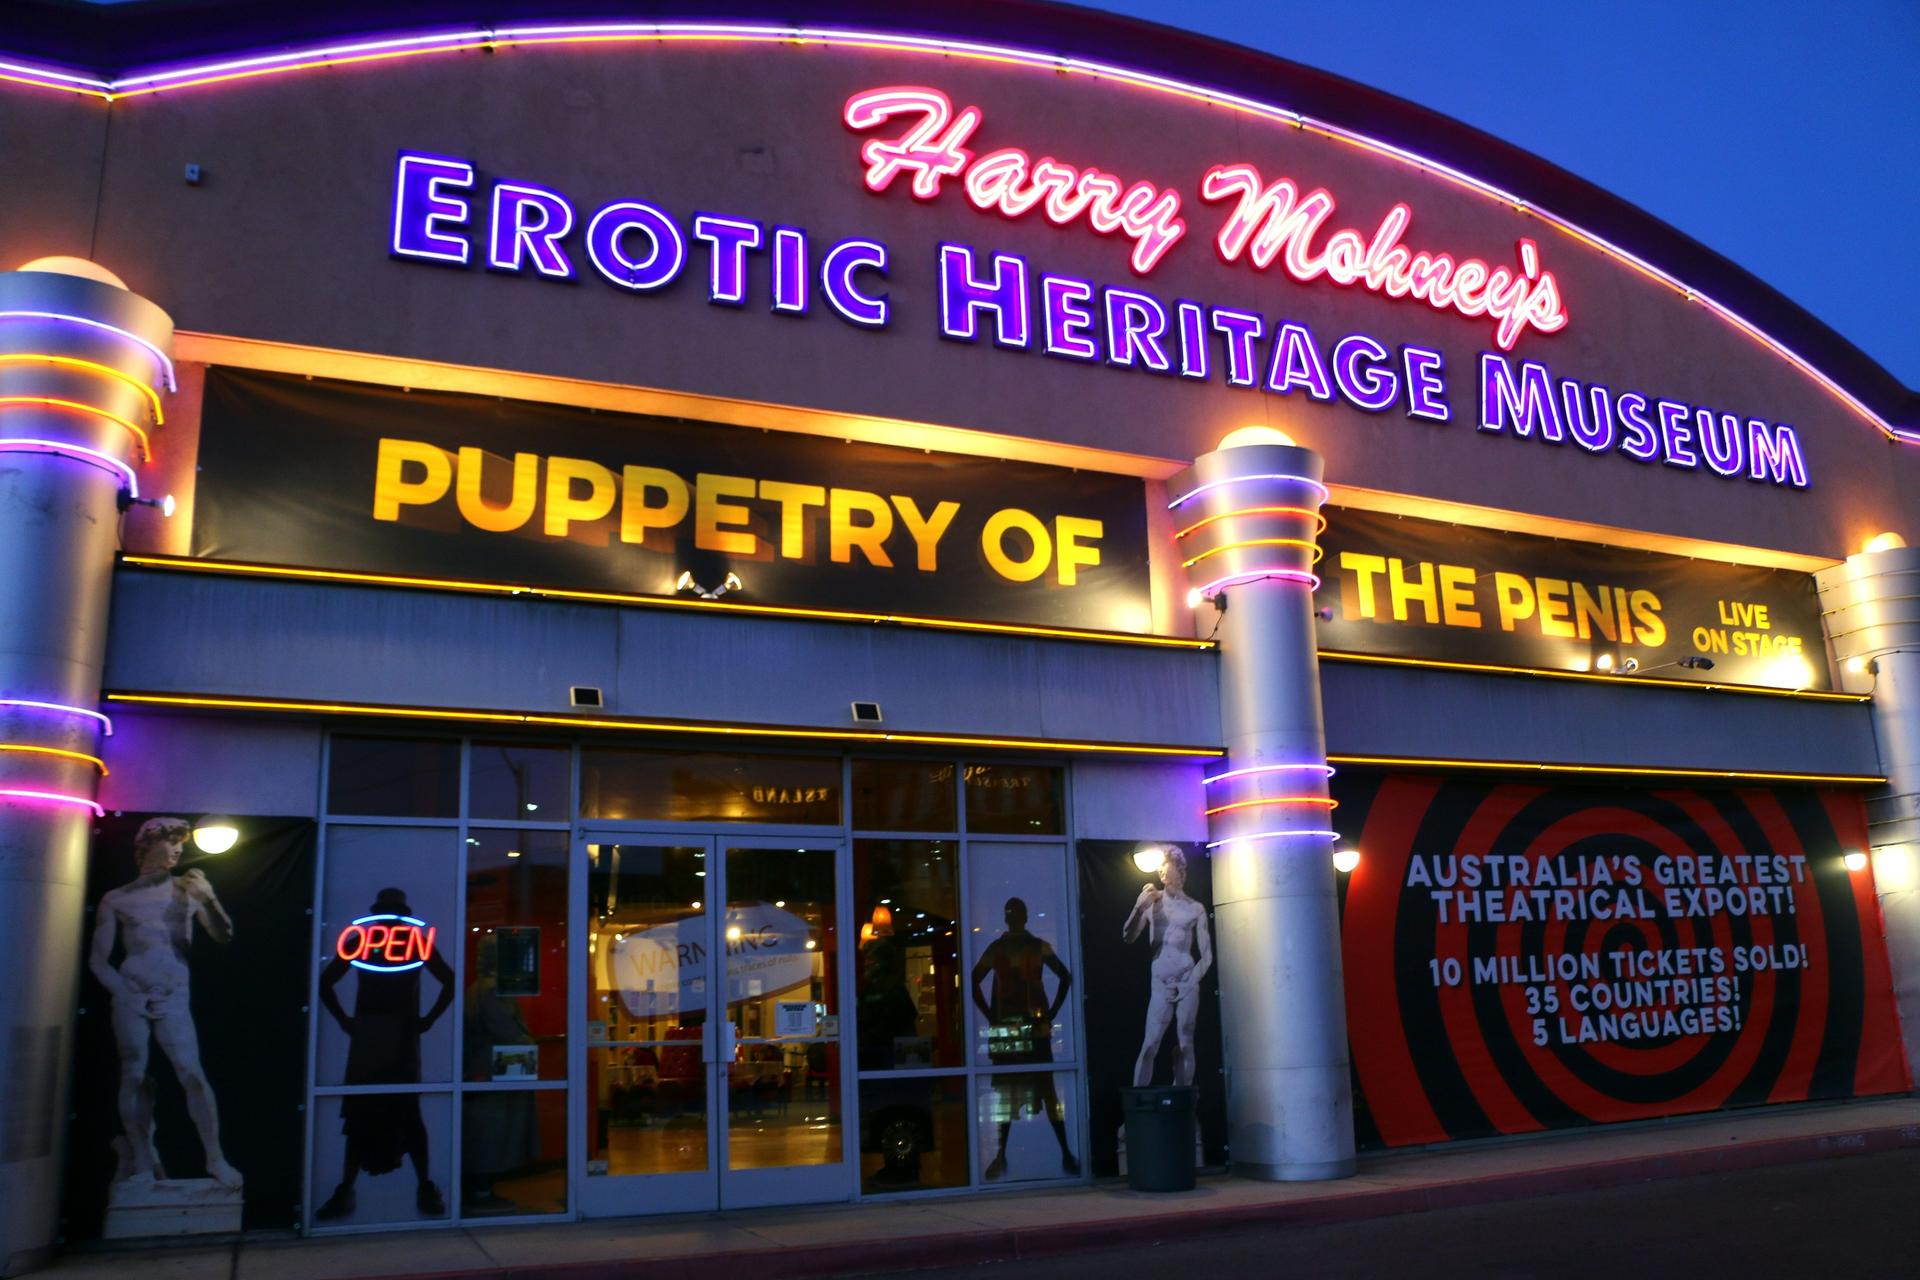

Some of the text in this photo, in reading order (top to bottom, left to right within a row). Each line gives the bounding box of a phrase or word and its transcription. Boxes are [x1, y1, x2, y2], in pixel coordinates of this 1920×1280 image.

[843, 87, 1567, 351] Harry Mohney's
[391, 150, 1809, 488] EROTIC HERITAGE MUSEUM
[373, 438, 1104, 586] PUPPETRY OF
[1340, 551, 1667, 648] THE PENIS
[1718, 600, 1770, 630] LIVE
[1692, 626, 1802, 657] ON STAGE
[1407, 854, 1807, 888] AUSTRALIA'S GREATEST
[1431, 886, 1797, 923] THEATRICAL EXPORT!
[337, 925, 437, 961] OPEN
[1429, 944, 1810, 987] 10 MILLION TICKETS SOLD!
[1525, 976, 1741, 1015] 35 COUNTRIES!
[1532, 1005, 1742, 1047] 5 LANGUAGES!
